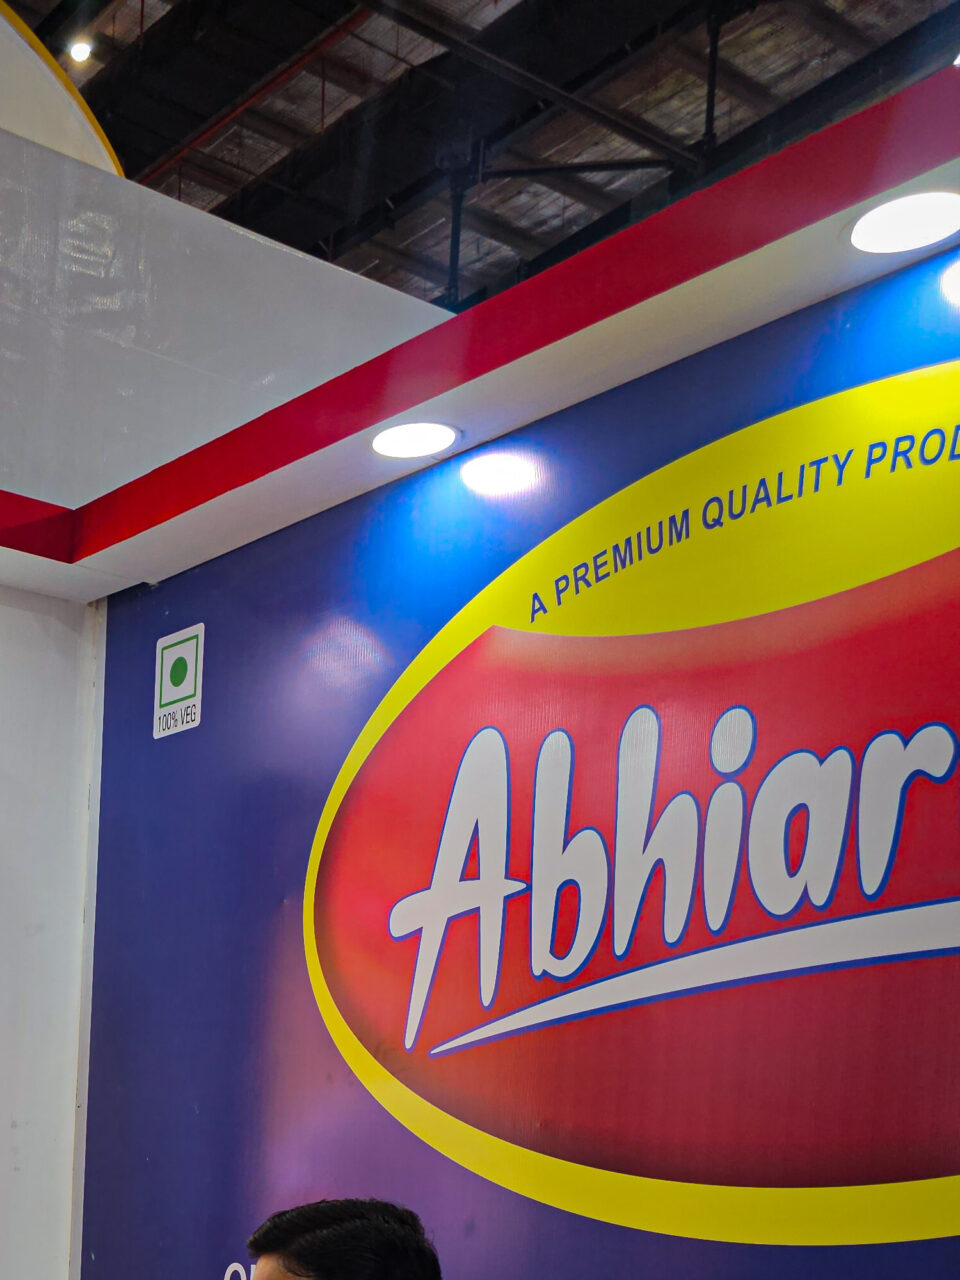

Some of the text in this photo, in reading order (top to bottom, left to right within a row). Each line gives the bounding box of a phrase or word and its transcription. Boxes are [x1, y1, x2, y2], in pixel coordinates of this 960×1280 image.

[530, 592, 547, 624] A
[554, 509, 691, 606] PREMIUM
[701, 449, 855, 530] QUALITY
[158, 704, 197, 733] 100% VEG
